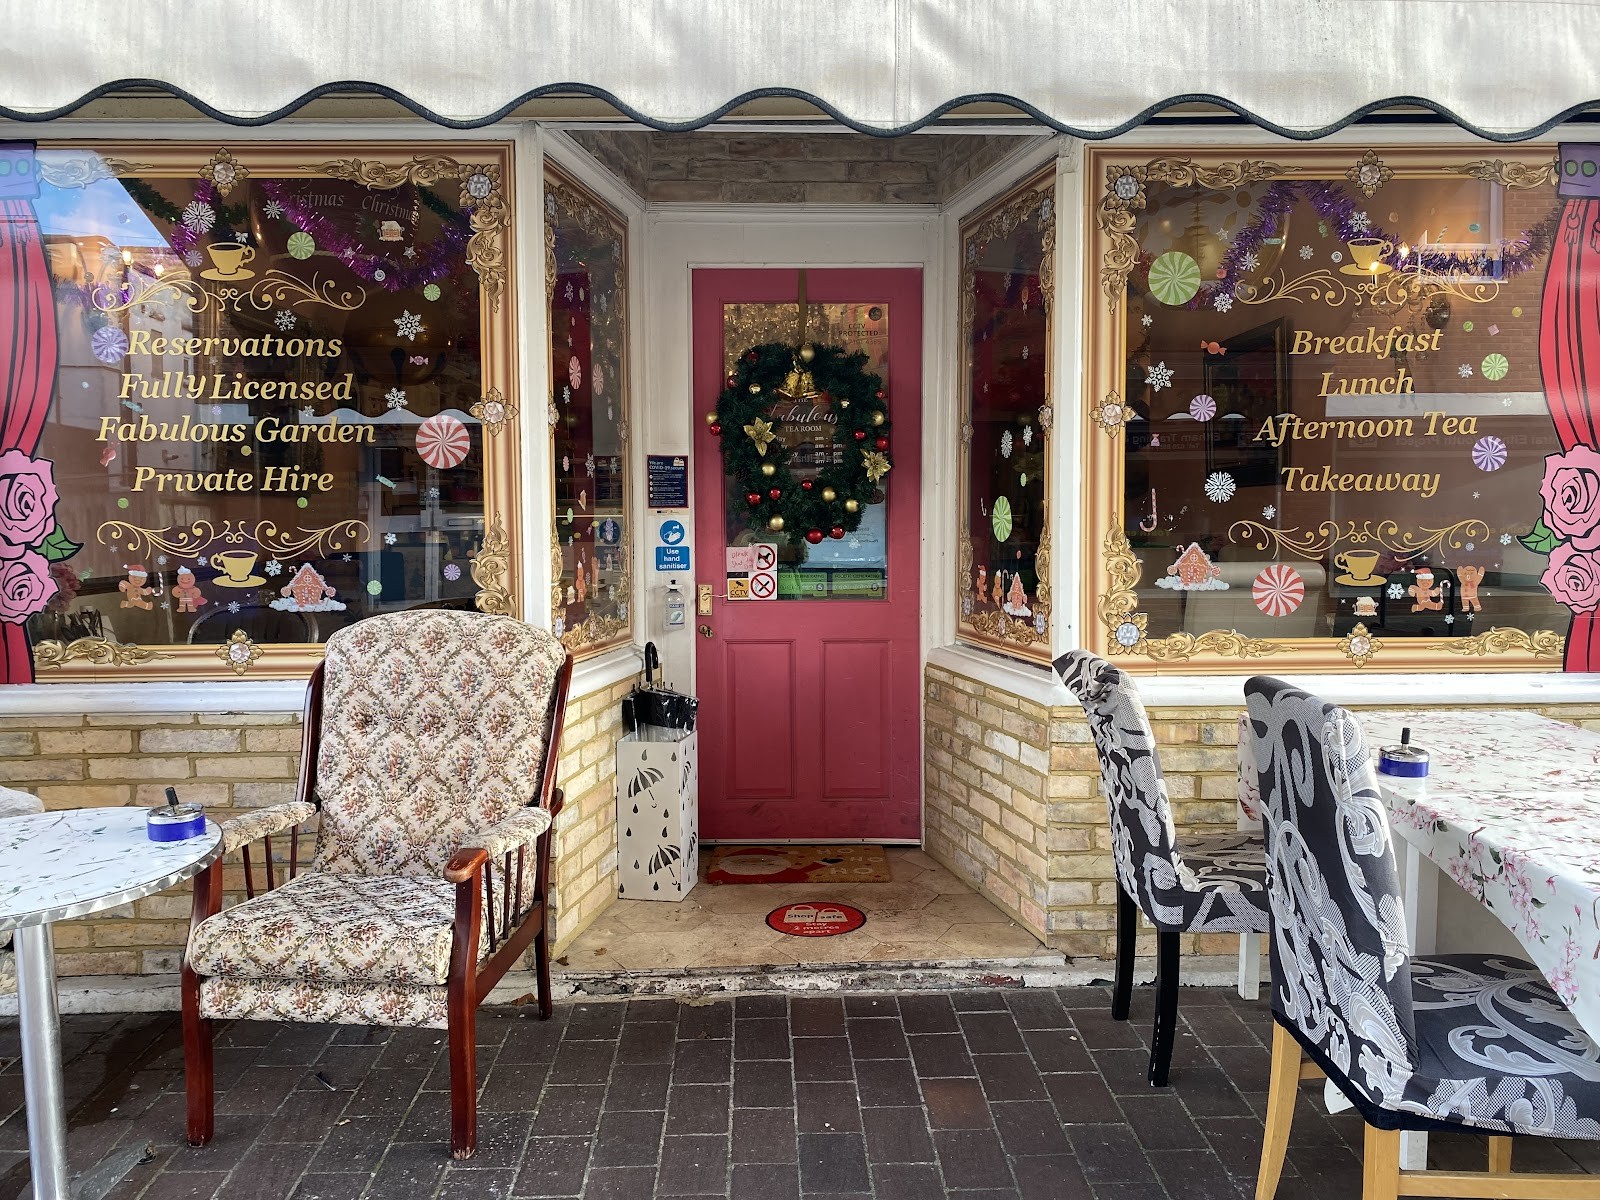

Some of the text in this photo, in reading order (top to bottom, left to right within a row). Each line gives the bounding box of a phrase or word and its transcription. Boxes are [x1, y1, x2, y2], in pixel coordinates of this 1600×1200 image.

[126, 331, 342, 357] Reservations
[1289, 326, 1443, 359] Breakfast
[117, 371, 353, 400] Fully Licensed
[1318, 368, 1415, 397] Lunch
[95, 415, 376, 443] Fabulous Garden
[785, 425, 799, 433] TEA
[1252, 411, 1478, 447] Afternoon Tea
[131, 464, 334, 492] Private Hire
[1281, 466, 1441, 498] Takeaway
[817, 847, 855, 855] HO
[830, 867, 874, 875] HO
